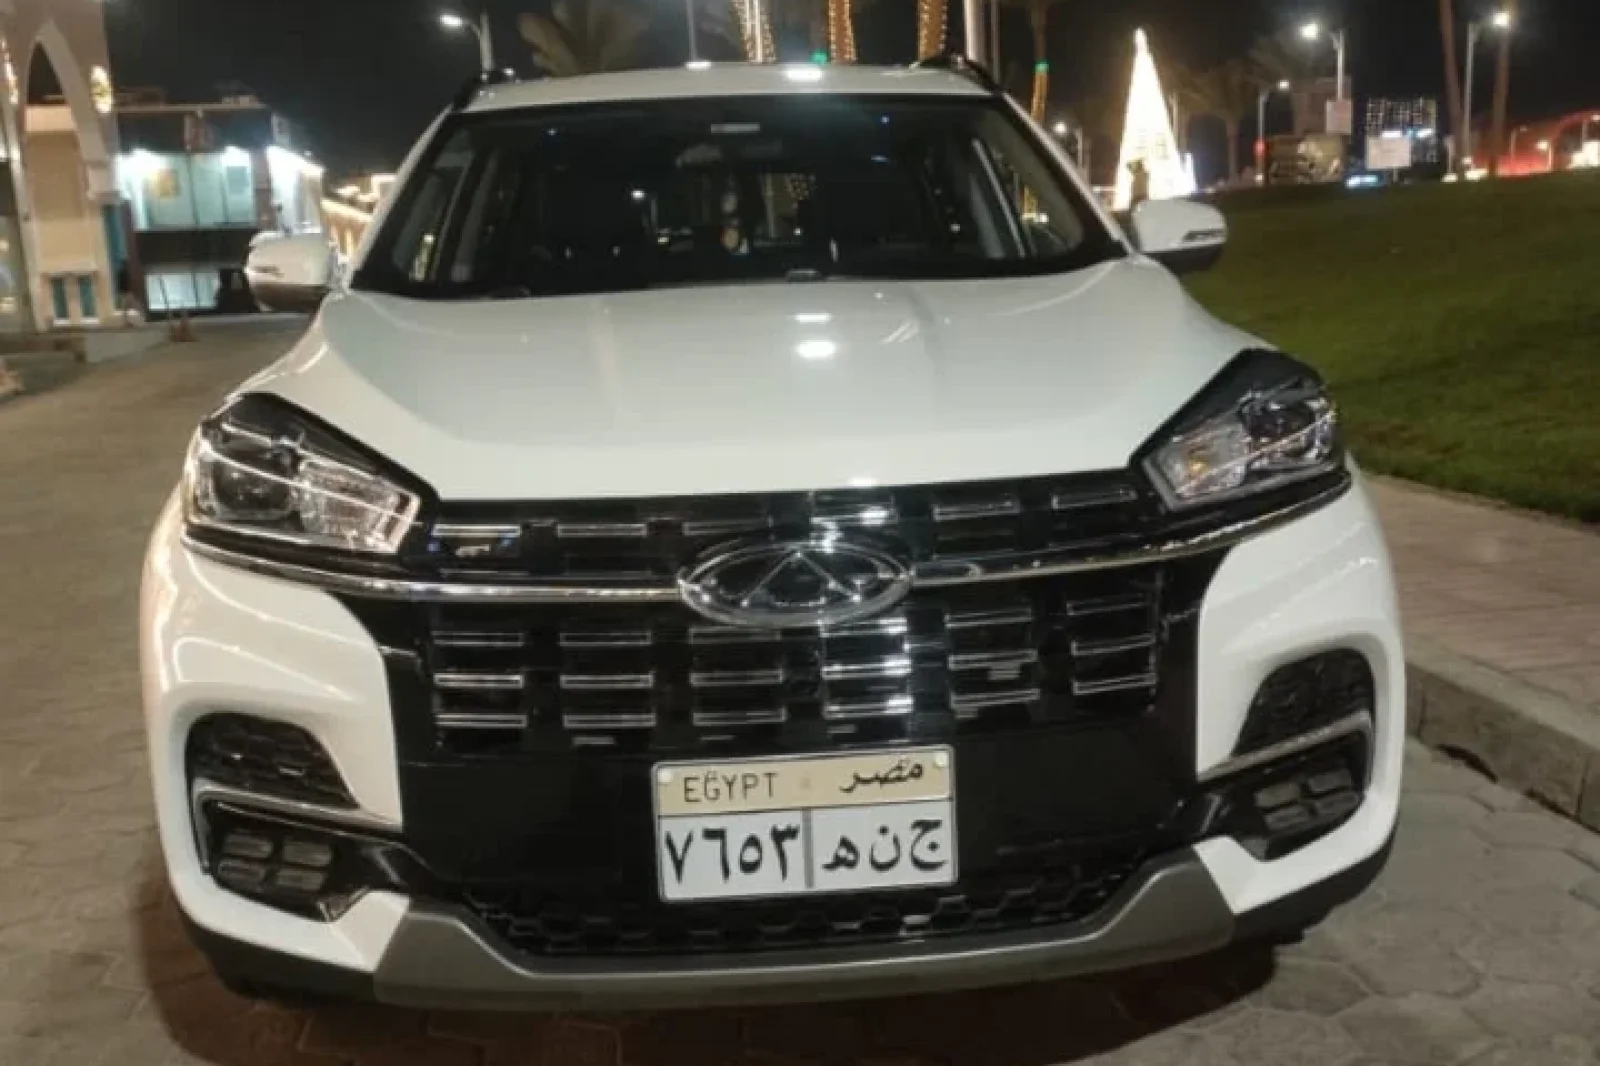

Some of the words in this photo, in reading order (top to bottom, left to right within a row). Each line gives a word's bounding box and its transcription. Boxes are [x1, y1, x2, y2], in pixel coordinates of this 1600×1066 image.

[683, 771, 779, 803] EGYPT
[839, 758, 924, 794] مصر
[664, 823, 801, 885] ٧٦٥٣
